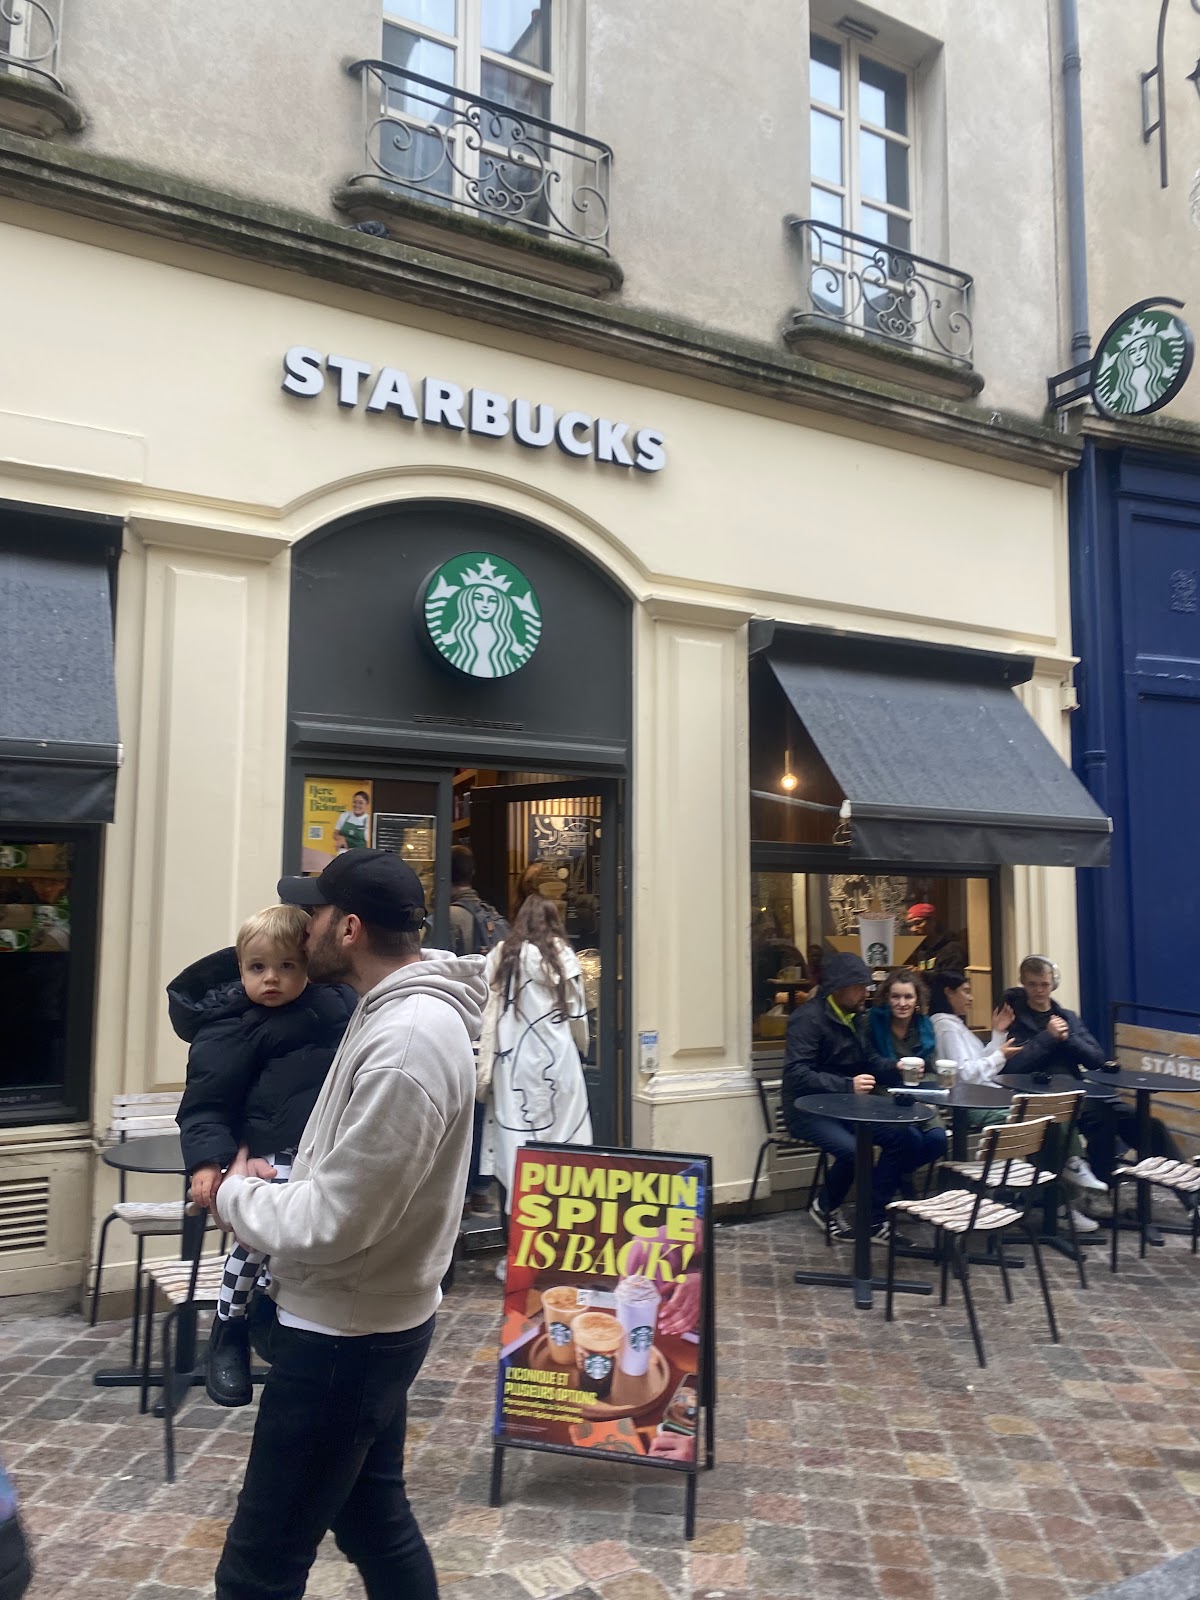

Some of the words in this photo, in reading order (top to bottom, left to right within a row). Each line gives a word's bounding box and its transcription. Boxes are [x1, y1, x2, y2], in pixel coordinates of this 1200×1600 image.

[281, 345, 667, 473] STARBUCKS
[520, 1162, 698, 1207] PUMPKIN
[516, 1194, 697, 1242] SPICE
[512, 1229, 561, 1270] IS
[558, 1233, 695, 1284] BACK!
[504, 1382, 555, 1400] PLUSIEURS
[558, 1372, 570, 1386] ET
